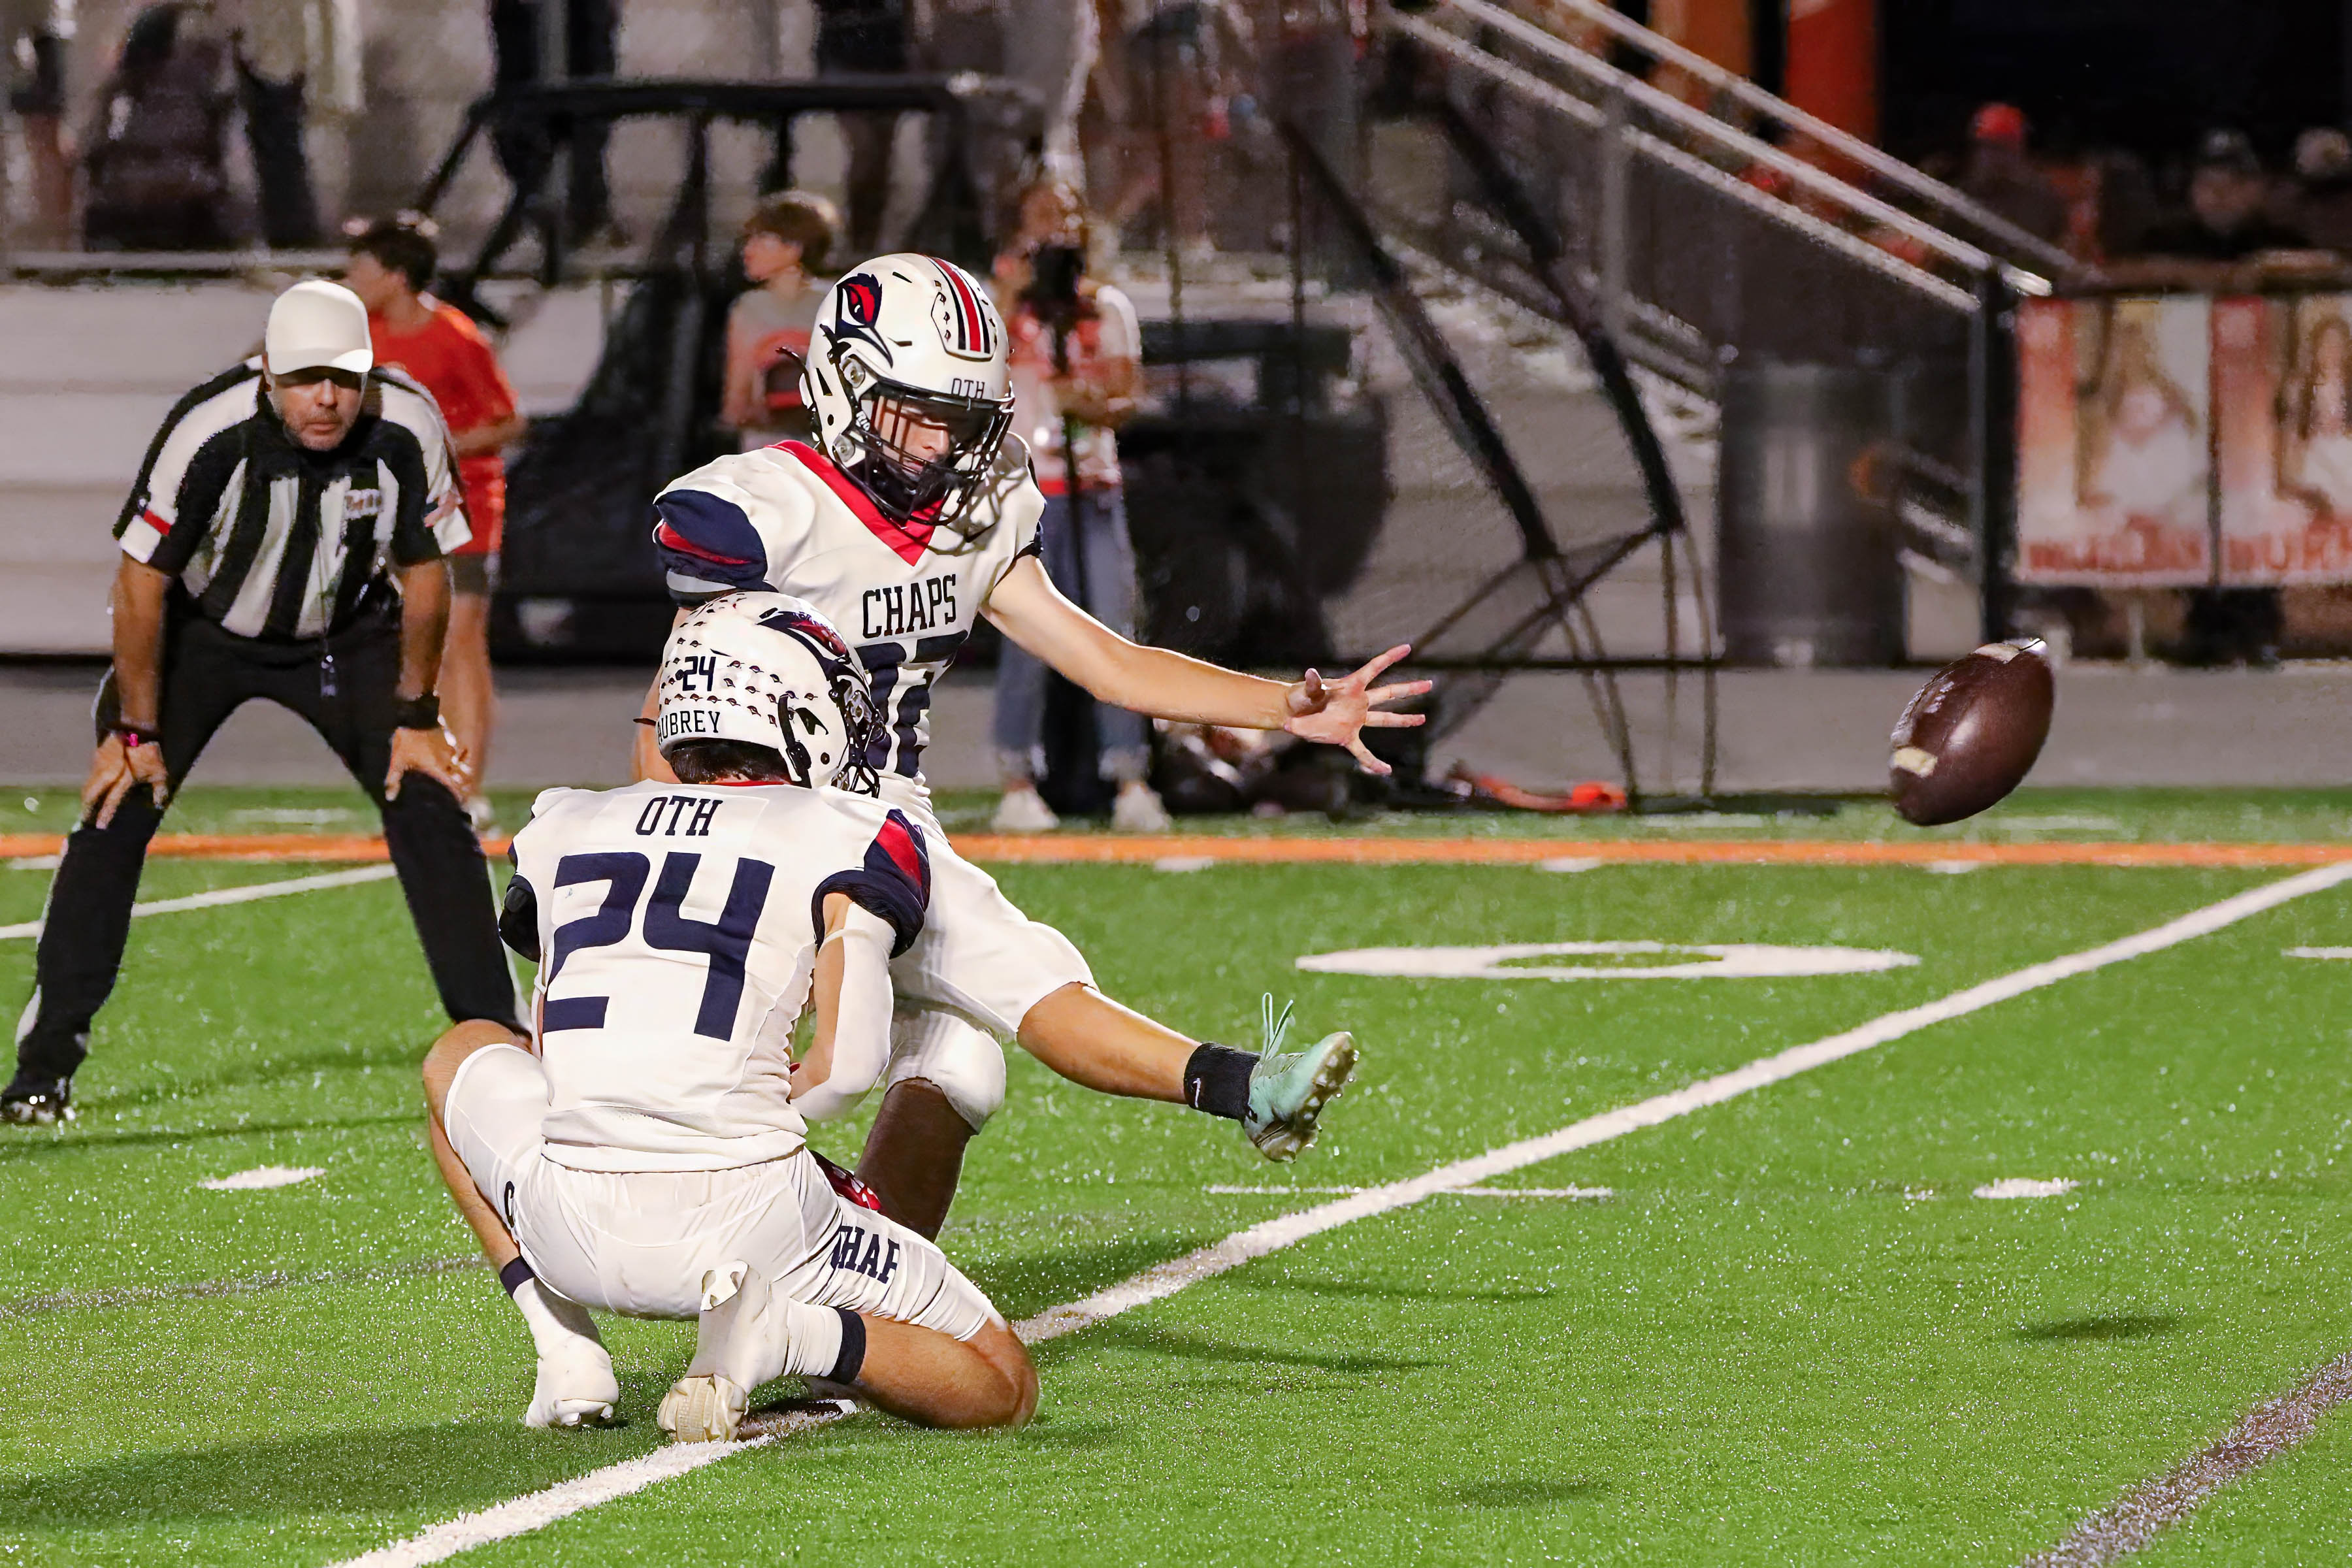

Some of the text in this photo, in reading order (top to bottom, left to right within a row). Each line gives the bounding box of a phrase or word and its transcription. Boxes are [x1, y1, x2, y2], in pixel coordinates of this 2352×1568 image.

[951, 378, 985, 399] OTH
[862, 574, 956, 639] CHAPS
[682, 656, 717, 691] 24
[635, 795, 723, 836] OTH
[542, 851, 776, 1041] 24
